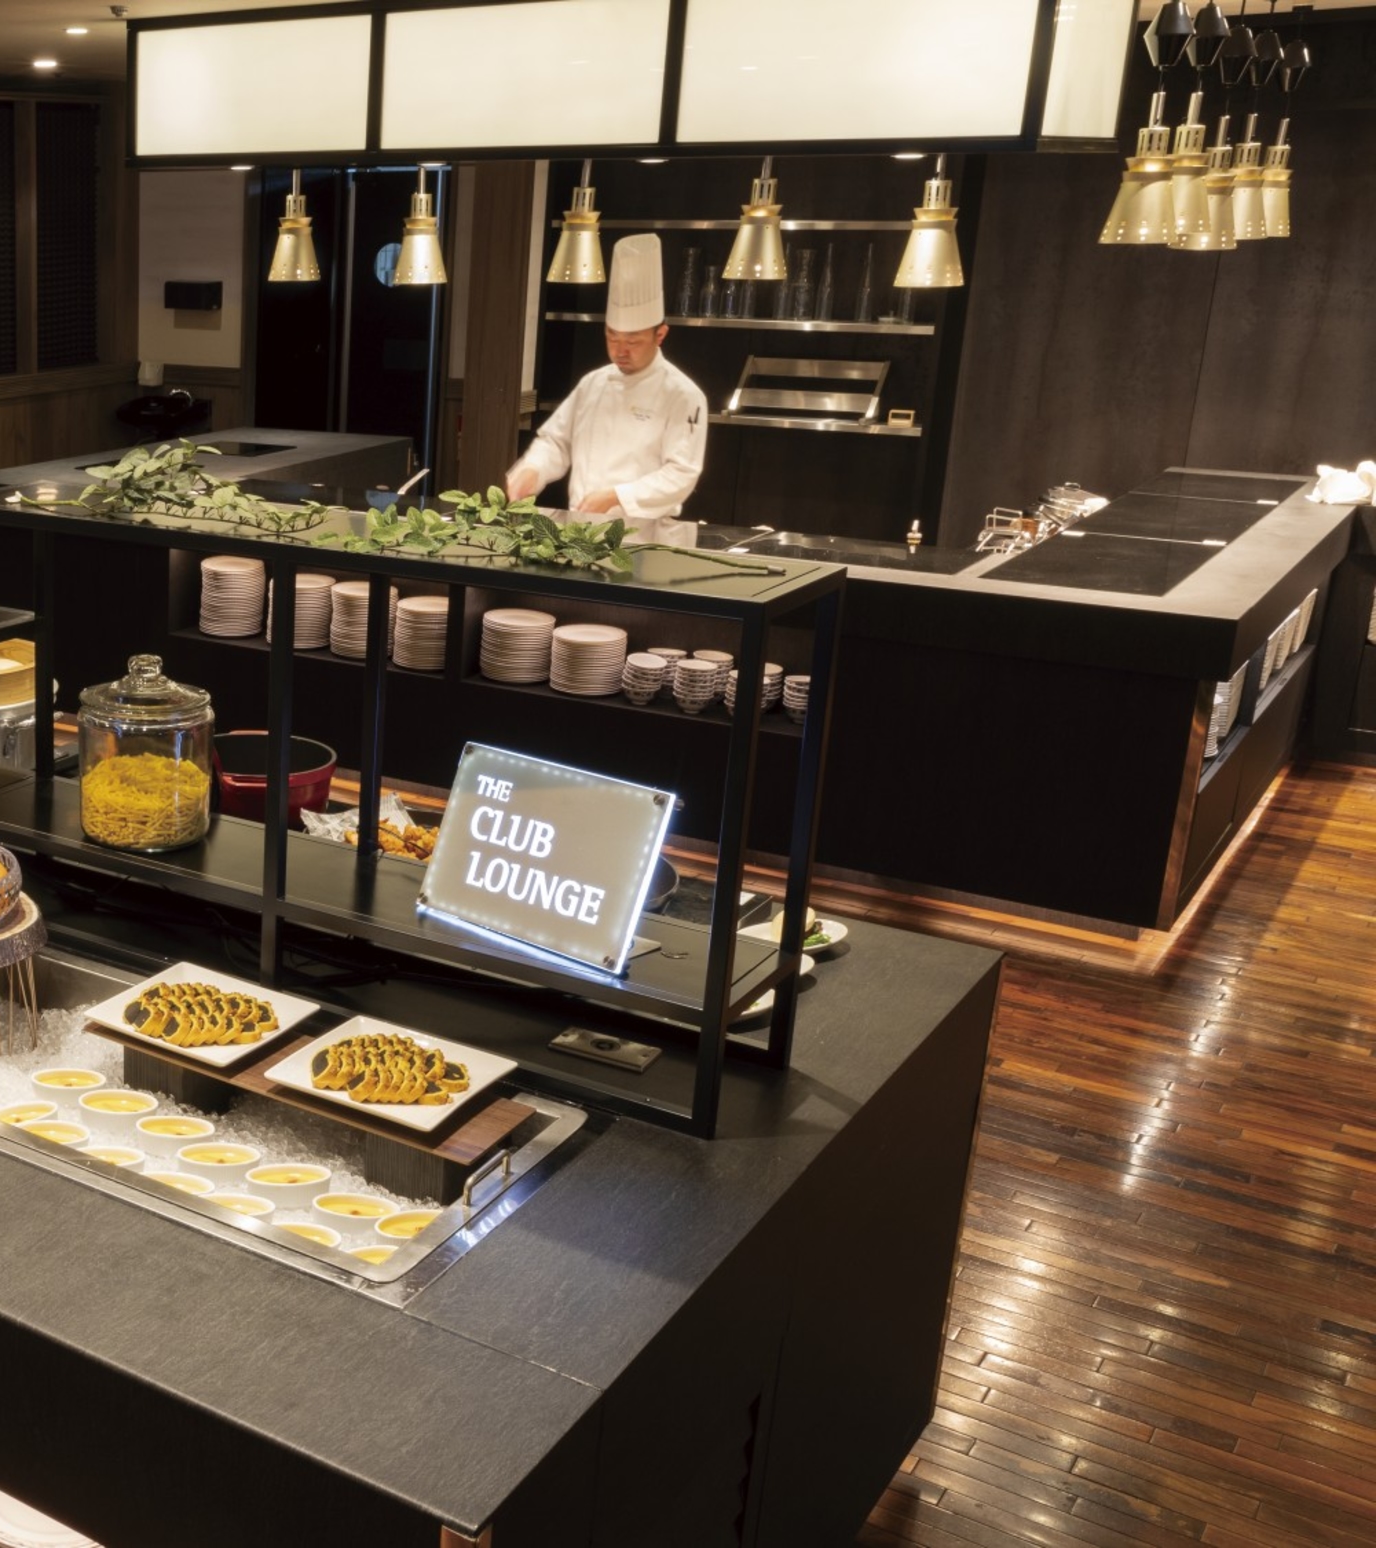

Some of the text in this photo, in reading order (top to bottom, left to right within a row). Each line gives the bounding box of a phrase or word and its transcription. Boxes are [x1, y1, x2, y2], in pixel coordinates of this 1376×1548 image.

[477, 774, 514, 802] THE
[470, 805, 556, 858] CLUB
[466, 851, 606, 925] LOUNGE
